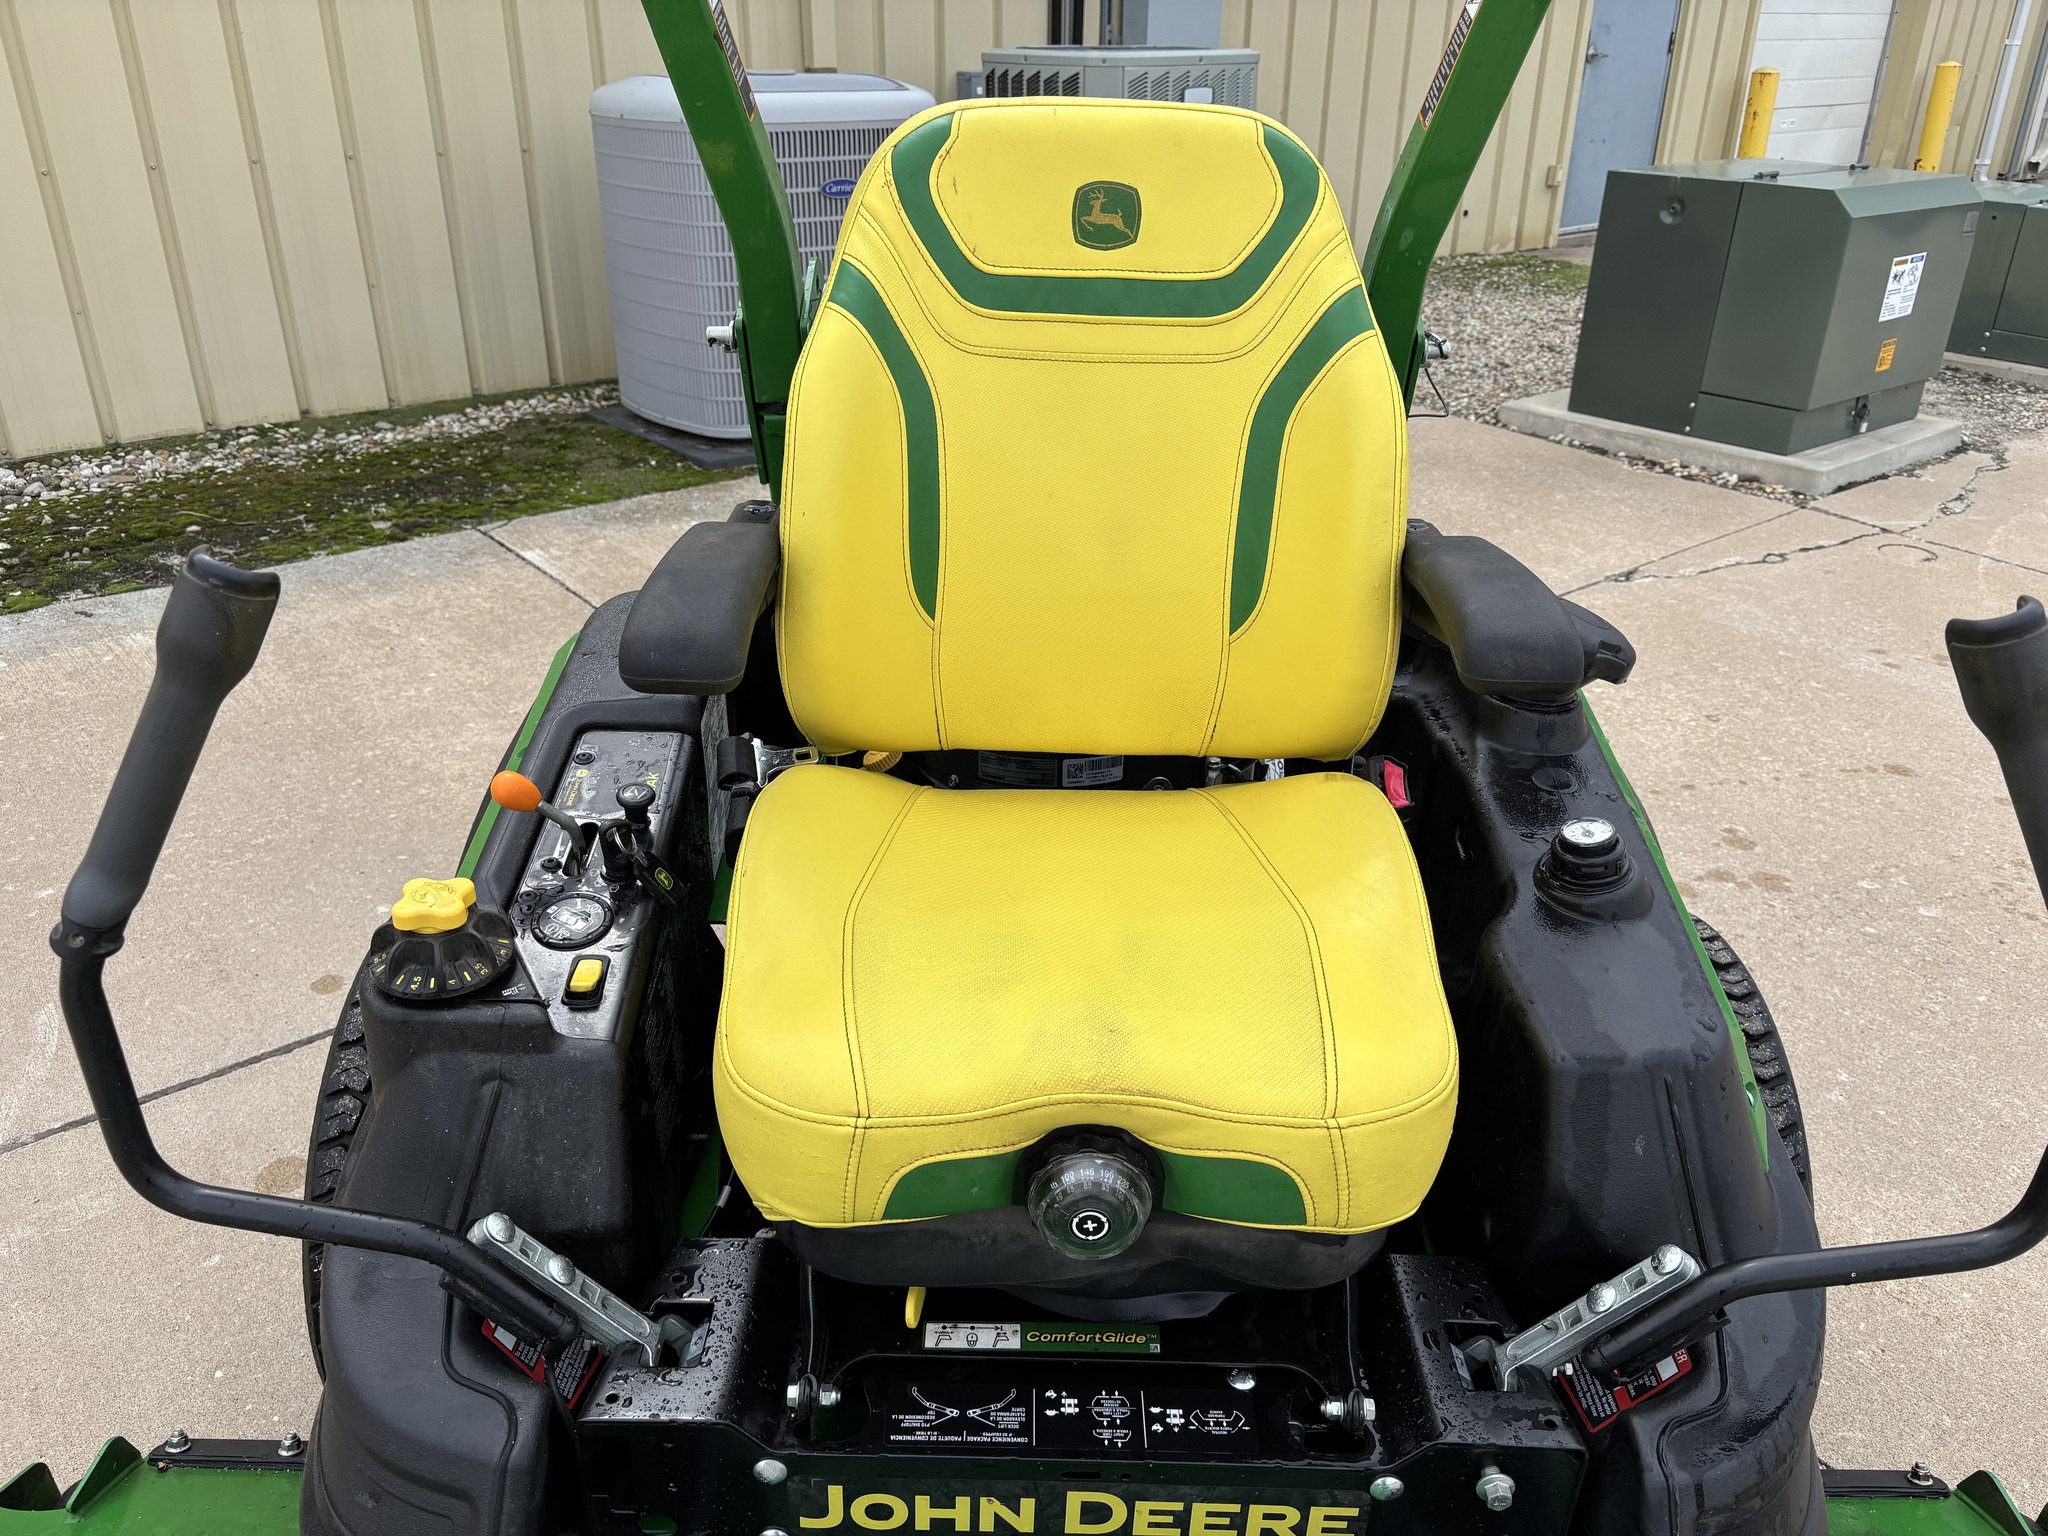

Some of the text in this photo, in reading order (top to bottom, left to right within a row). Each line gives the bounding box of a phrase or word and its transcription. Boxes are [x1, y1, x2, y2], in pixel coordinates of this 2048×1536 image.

[474, 962, 488, 975] 3.5
[1061, 1171, 1075, 1182] 100
[1080, 1168, 1095, 1177] 145
[1100, 1169, 1114, 1180] 190
[1118, 1176, 1130, 1188] 235
[800, 1484, 1360, 1536] JOHN DEERE
